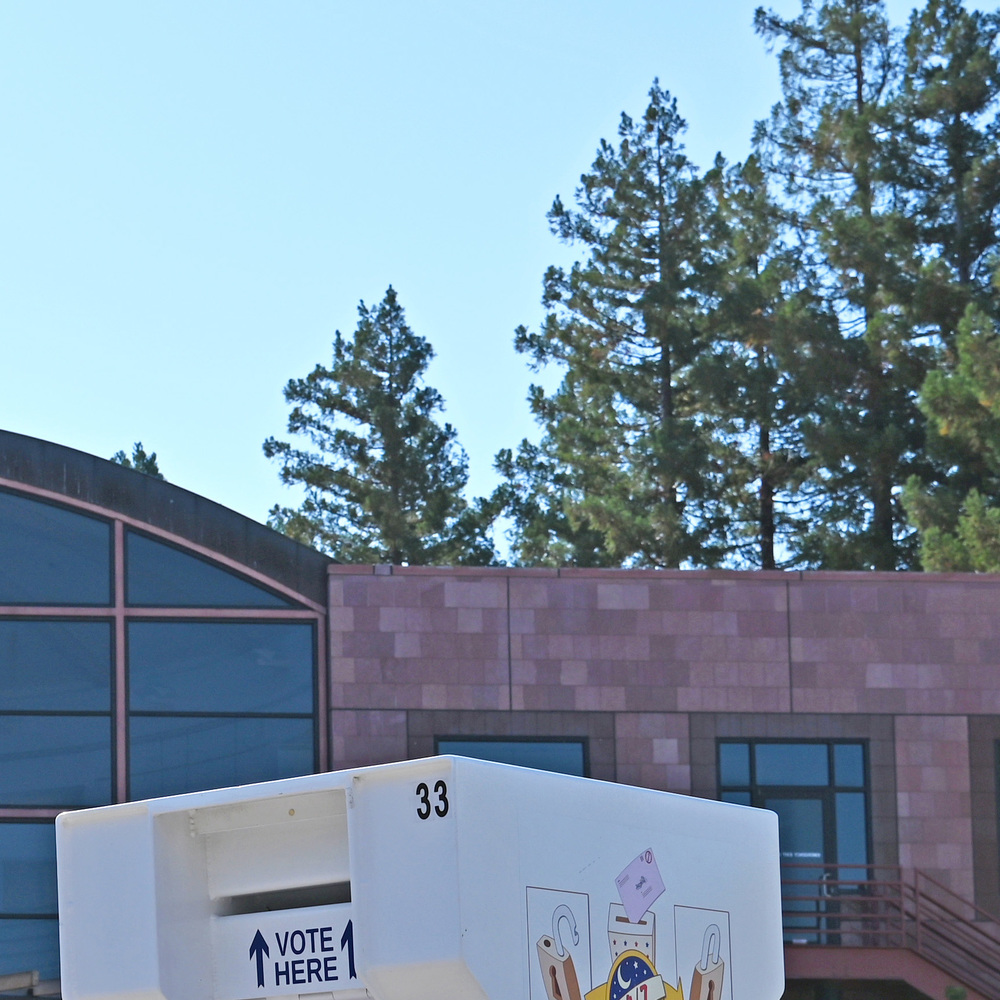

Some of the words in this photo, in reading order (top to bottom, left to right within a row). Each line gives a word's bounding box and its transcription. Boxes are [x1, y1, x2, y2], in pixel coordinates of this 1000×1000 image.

[415, 780, 449, 820] 33
[274, 926, 335, 957] VOTE
[274, 956, 339, 986] HERE
